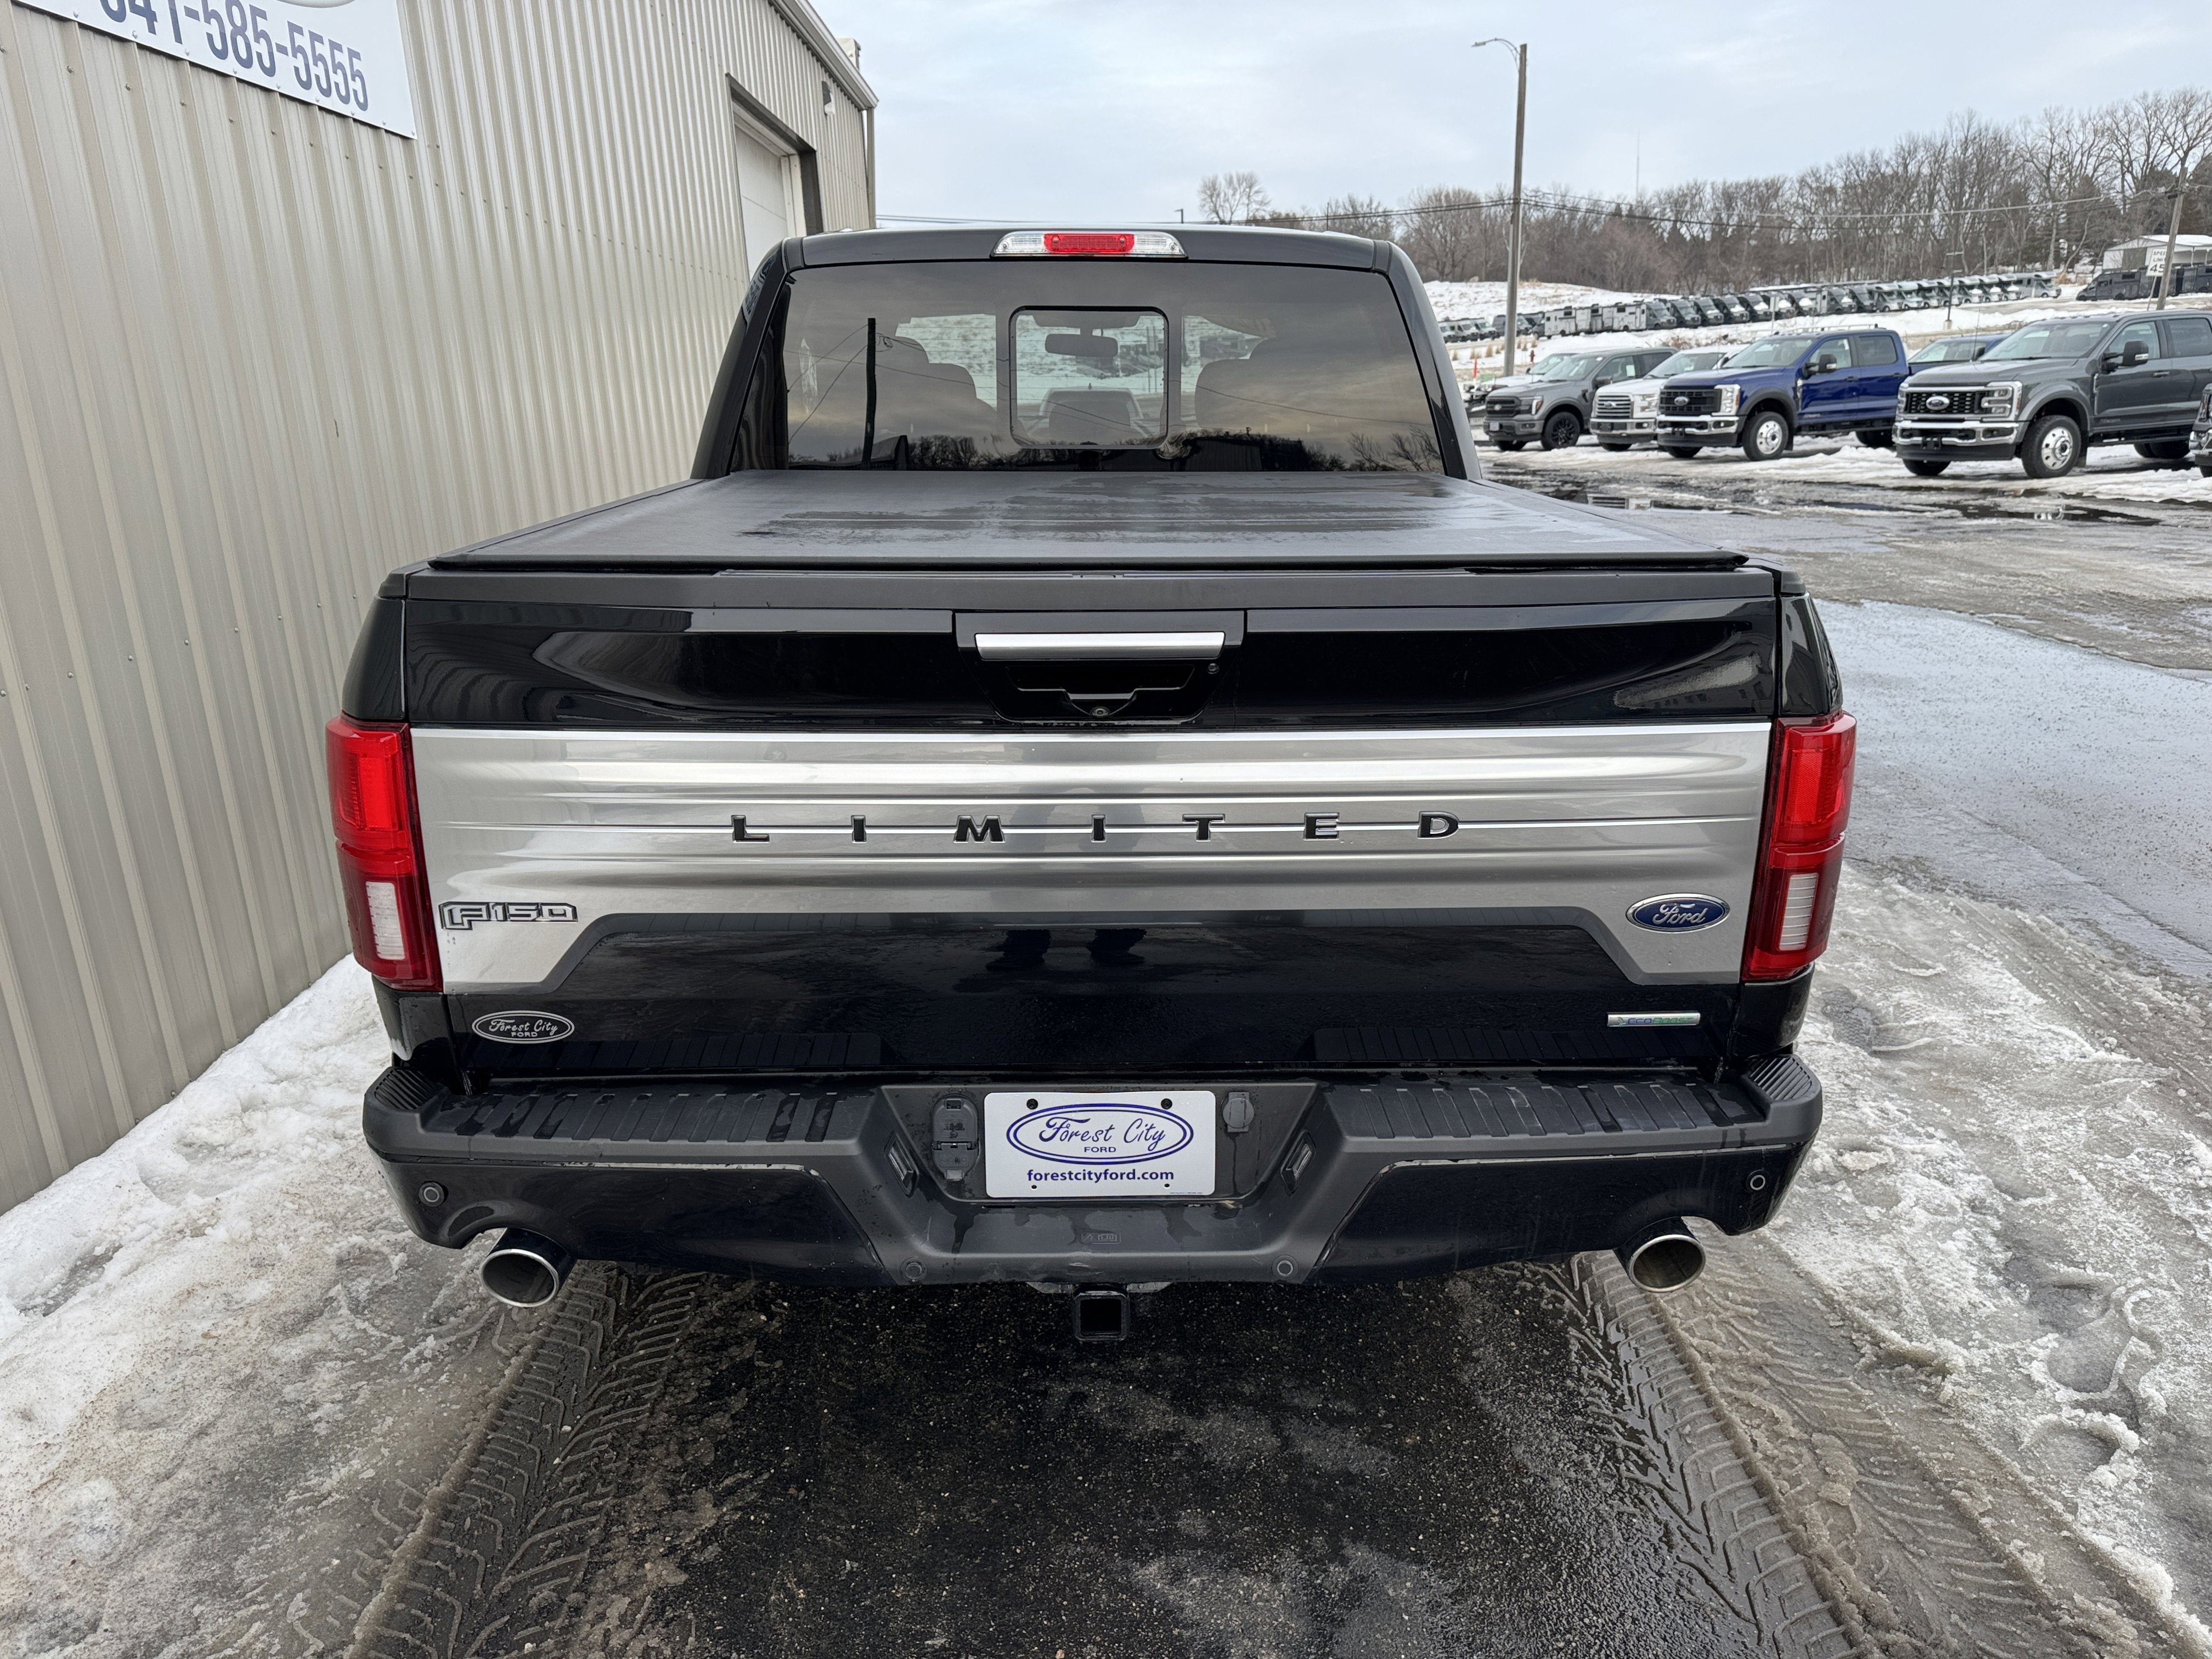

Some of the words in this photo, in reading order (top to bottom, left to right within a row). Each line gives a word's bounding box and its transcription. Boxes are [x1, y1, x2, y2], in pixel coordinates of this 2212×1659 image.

[731, 811, 1459, 843] LIMITED
[1652, 902, 1708, 925] Ford
[489, 1019, 530, 1032] Forest
[533, 1019, 558, 1036] City
[1039, 1116, 1115, 1143] Forest
[1123, 1118, 1166, 1151] City
[1027, 1169, 1175, 1183] forestcityford.com
